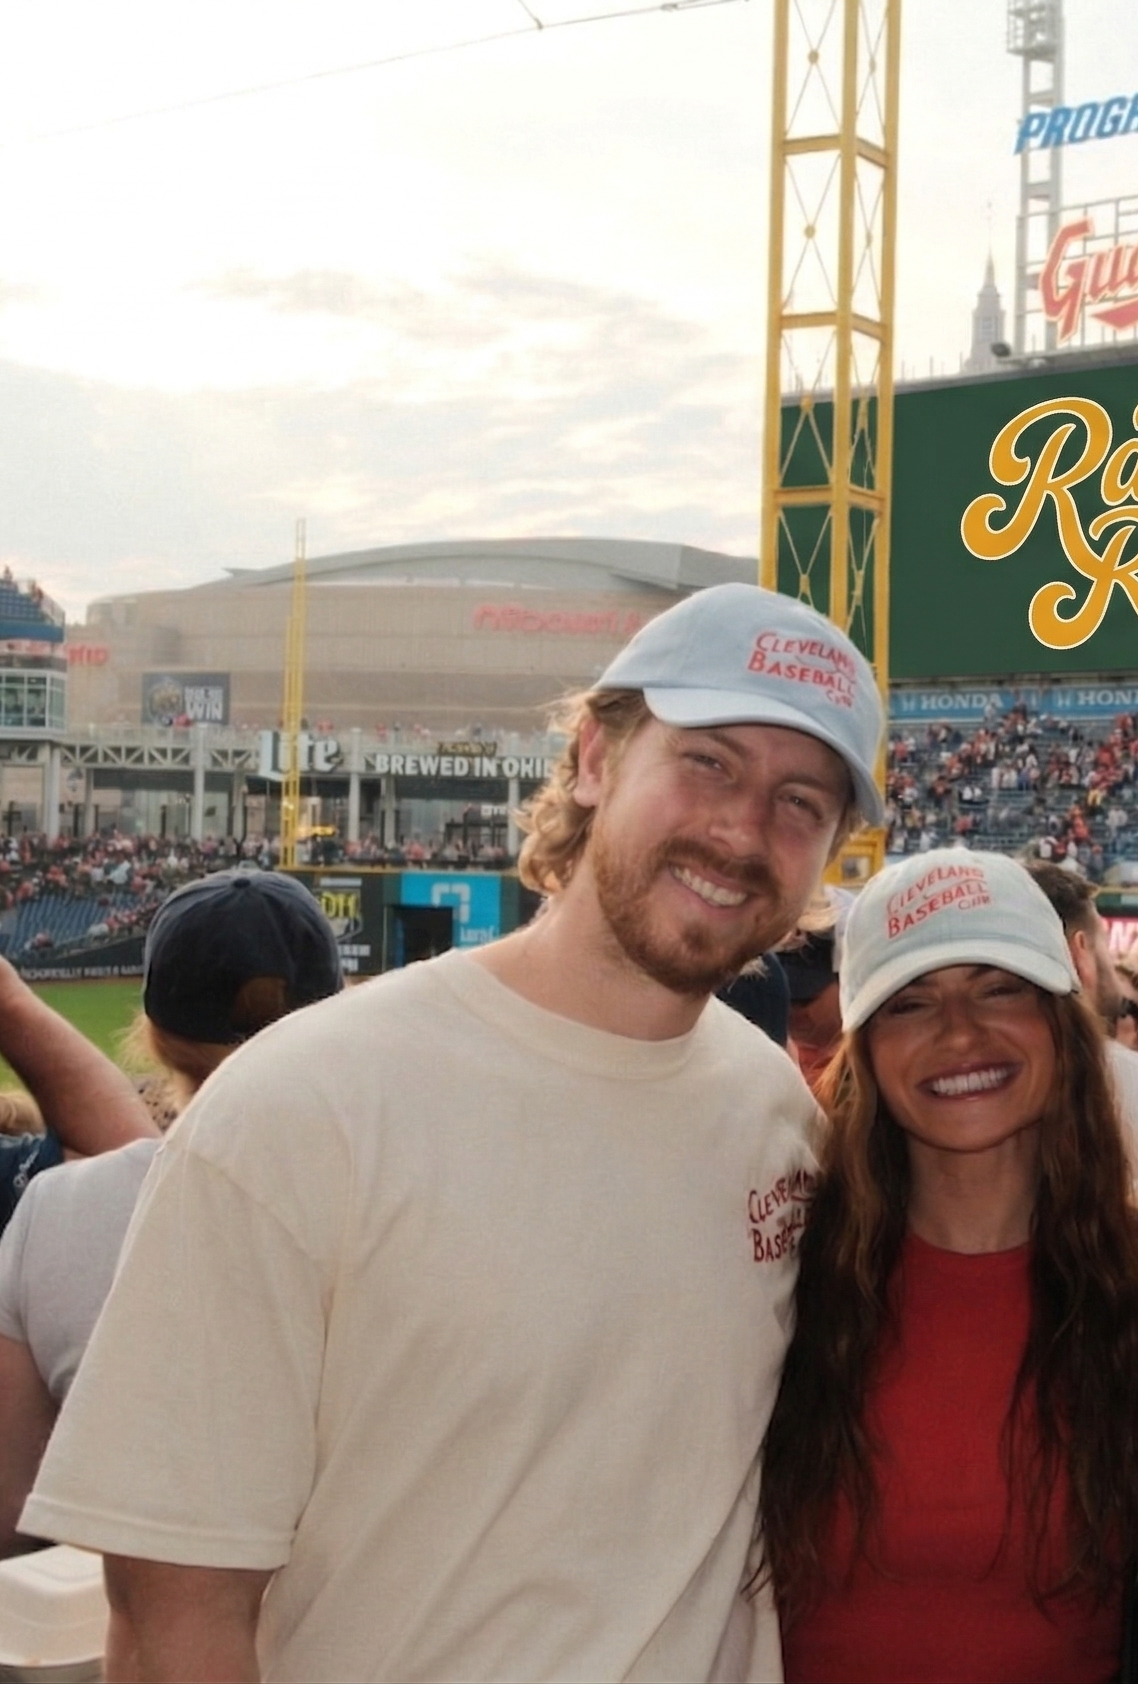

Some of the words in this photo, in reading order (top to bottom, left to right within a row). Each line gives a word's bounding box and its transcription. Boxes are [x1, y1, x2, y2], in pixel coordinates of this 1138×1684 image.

[920, 693, 1004, 711] HONDA
[375, 754, 470, 777] BREWED
[474, 756, 498, 778] IN
[887, 883, 989, 939] BASEBALL
